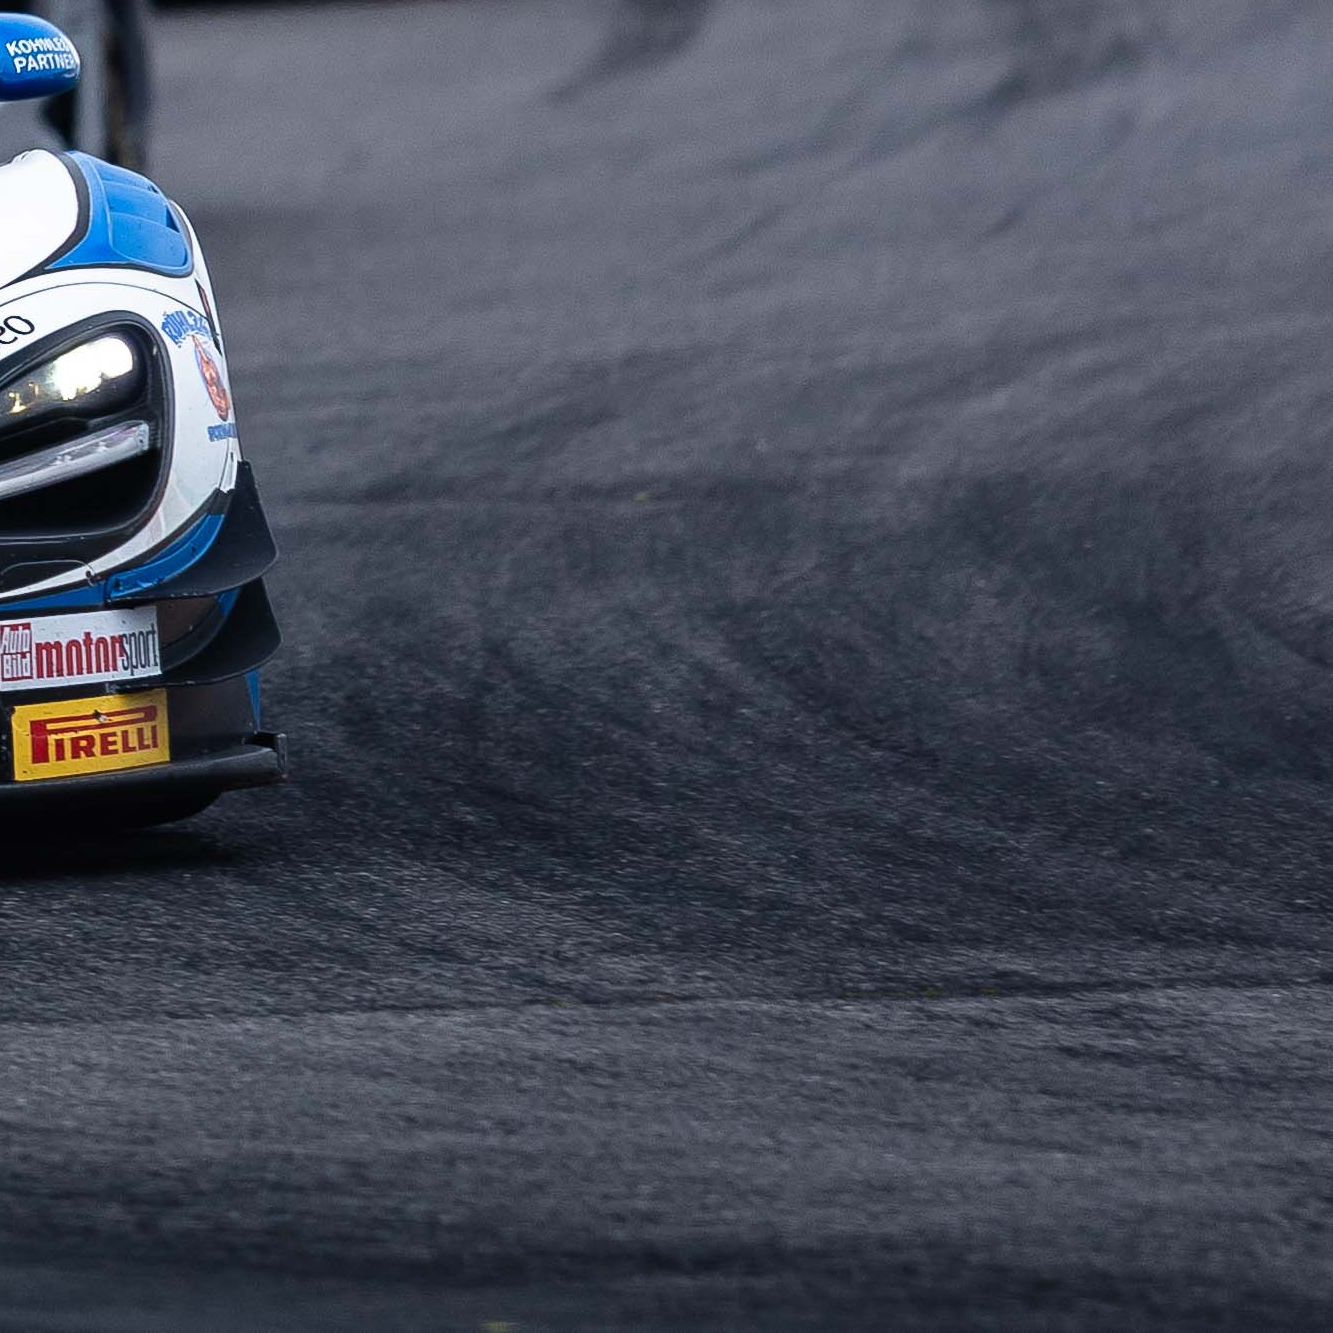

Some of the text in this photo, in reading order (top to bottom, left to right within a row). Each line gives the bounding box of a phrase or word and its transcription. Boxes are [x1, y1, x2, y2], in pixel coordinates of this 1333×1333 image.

[1, 626, 30, 654] Auto
[3, 652, 31, 678] Bild
[29, 704, 160, 765] PIRELLI
